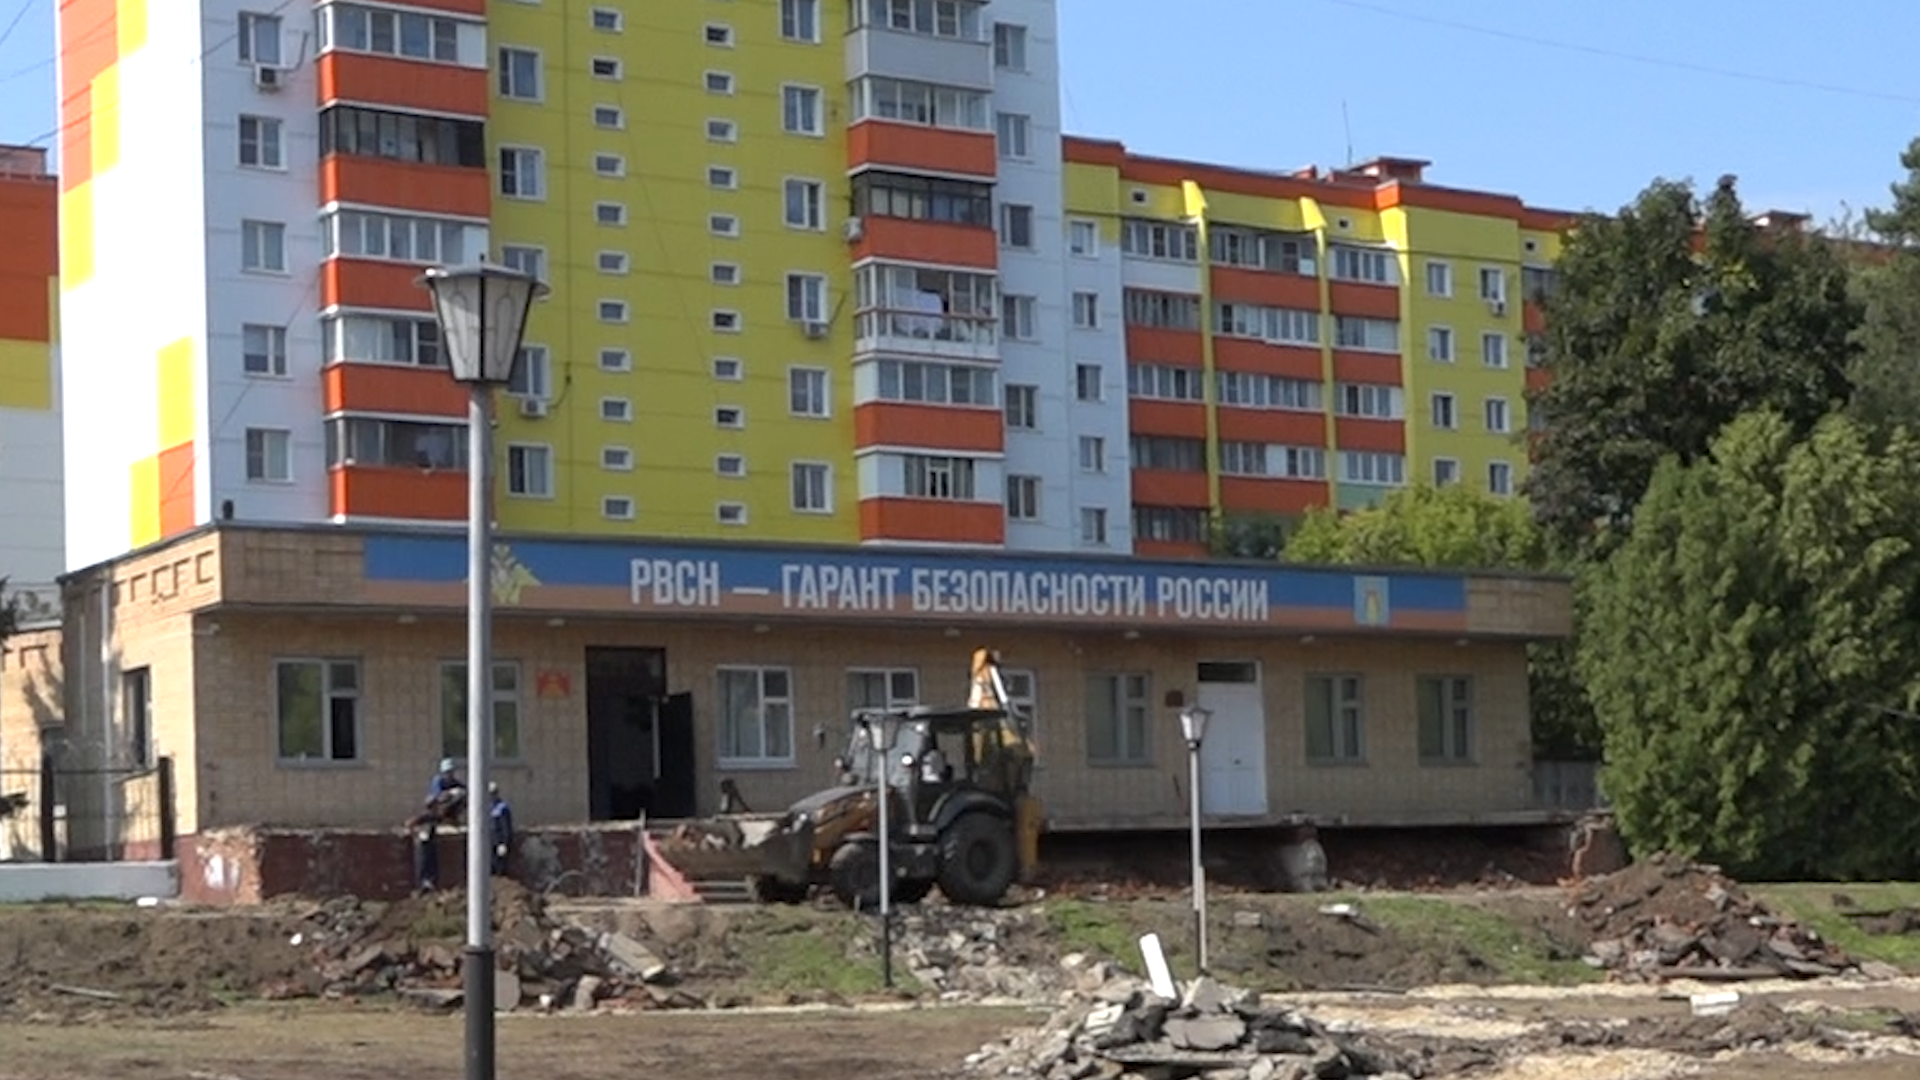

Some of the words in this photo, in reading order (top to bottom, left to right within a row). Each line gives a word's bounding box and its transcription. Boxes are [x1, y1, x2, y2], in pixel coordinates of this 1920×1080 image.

[630, 558, 719, 606] РВСН
[781, 564, 899, 611] ГАРАНТ
[911, 567, 1145, 617] БЕЗОПАСНОСТИ
[1157, 576, 1269, 622] РОССИИ
